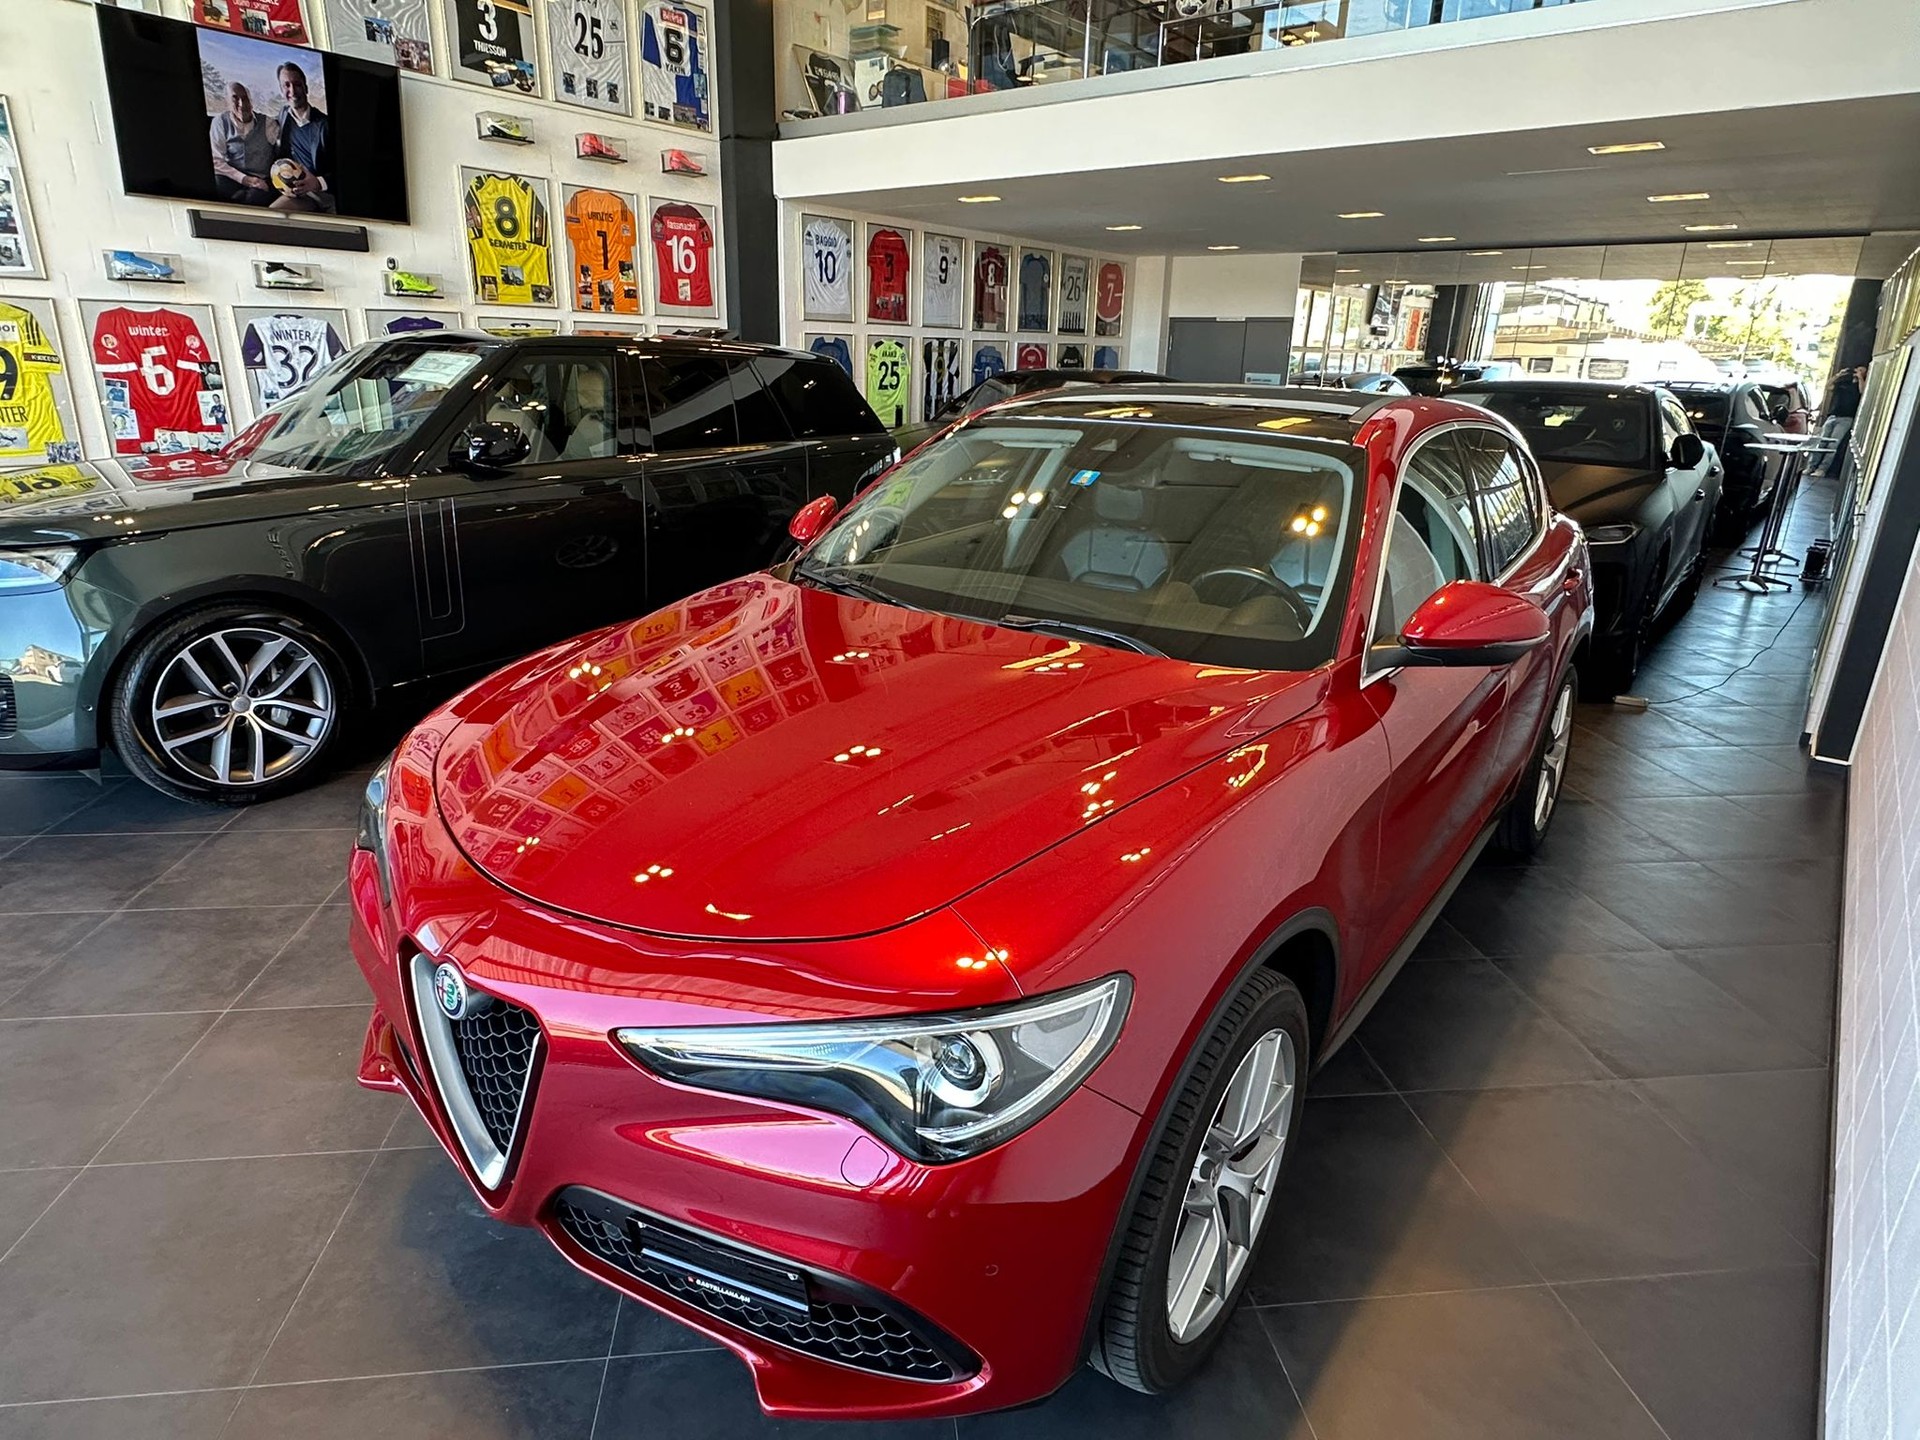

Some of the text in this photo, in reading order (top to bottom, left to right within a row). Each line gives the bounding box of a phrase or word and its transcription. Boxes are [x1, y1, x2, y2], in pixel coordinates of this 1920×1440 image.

[477, 0, 498, 41] 3
[574, 12, 604, 60] 25
[664, 27, 684, 65] 6
[665, 62, 686, 75] YAKIN
[495, 196, 520, 238] 8
[596, 230, 609, 270] 1
[666, 235, 697, 274] 16
[815, 249, 836, 284] 10
[939, 255, 949, 285] 9
[987, 263, 996, 287] 8
[1066, 275, 1081, 302] 26
[1107, 282, 1115, 307] 7
[128, 325, 169, 337] winter
[272, 329, 313, 341] WINTER
[141, 345, 176, 396] 6
[272, 344, 319, 389] 32
[878, 360, 900, 391] 25
[0, 404, 29, 424] NTER
